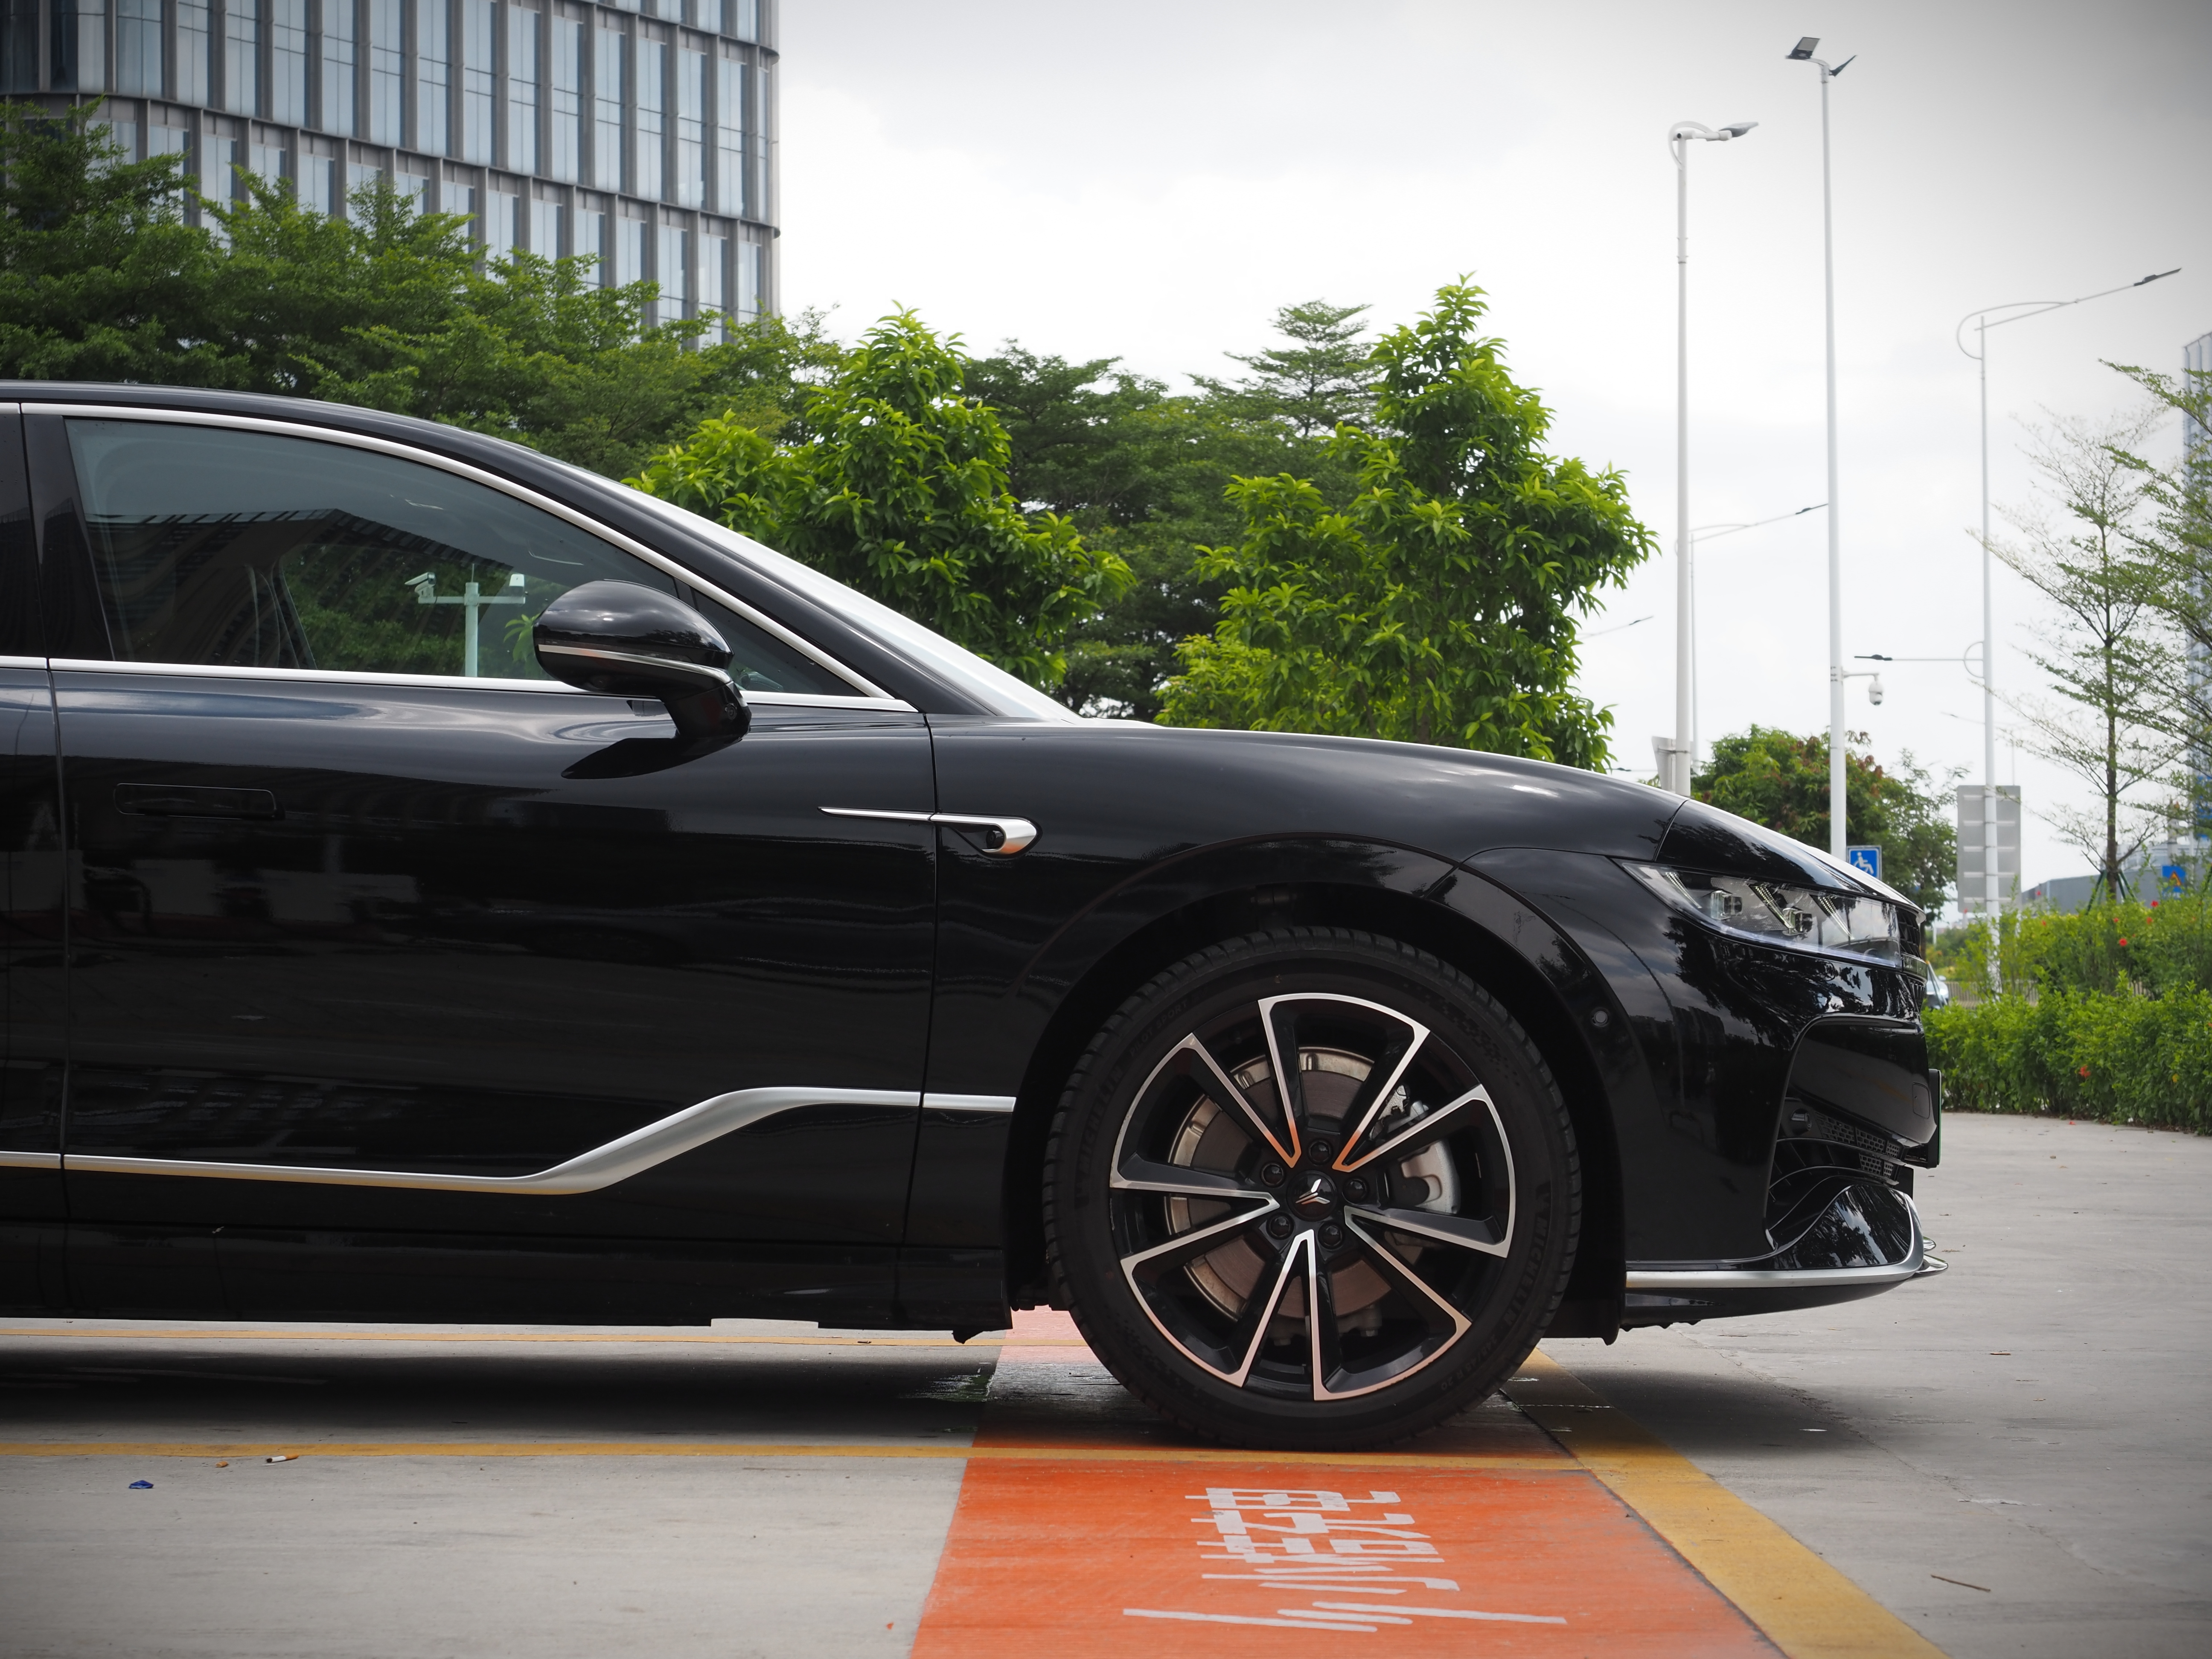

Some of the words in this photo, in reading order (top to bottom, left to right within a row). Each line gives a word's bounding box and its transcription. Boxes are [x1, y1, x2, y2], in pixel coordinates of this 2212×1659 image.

[1077, 1064, 1126, 1174] MICHELIN
[1127, 1027, 1155, 1058] PILOT
[1154, 999, 1189, 1030] SPORT
[1501, 1217, 1548, 1325] MICHELIN
[1439, 1376, 1455, 1391] 20
[1454, 1369, 1464, 1379] R
[1463, 1334, 1499, 1372] 245/45
[1185, 1487, 1459, 1595] 小桔充电
